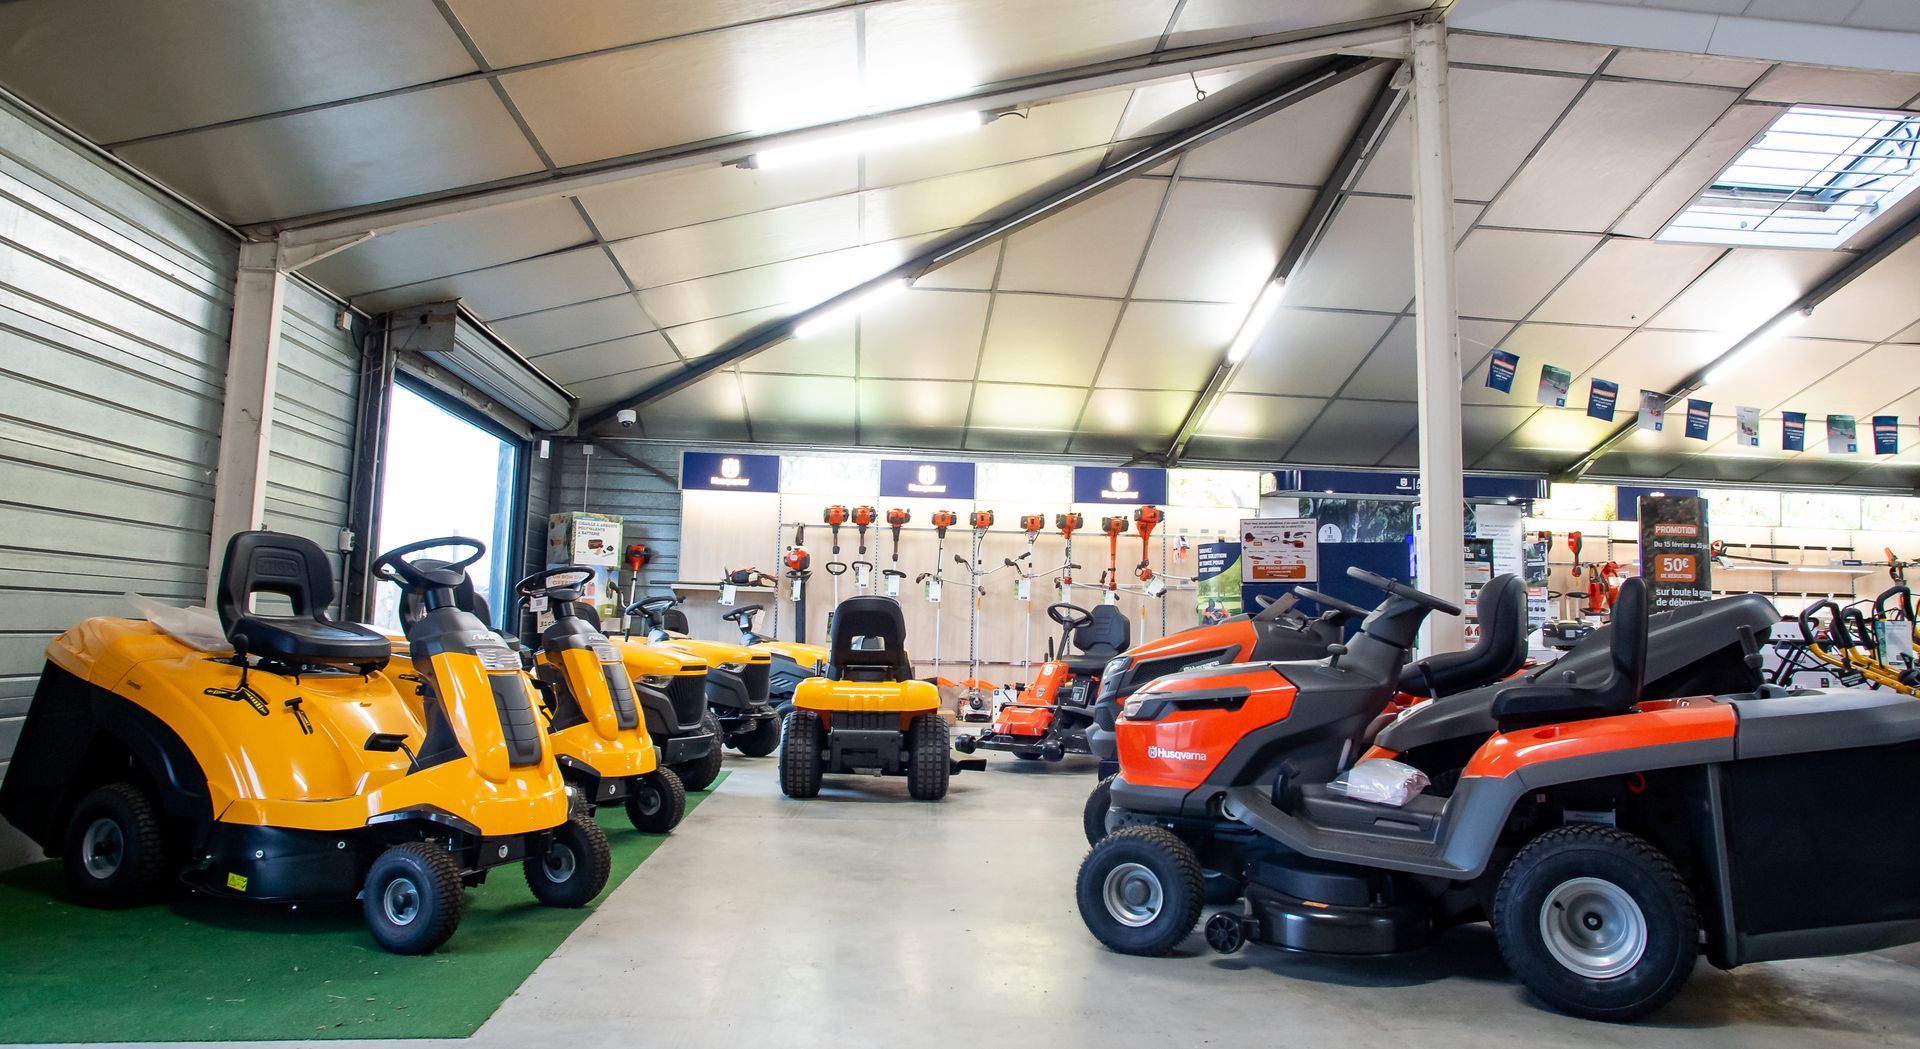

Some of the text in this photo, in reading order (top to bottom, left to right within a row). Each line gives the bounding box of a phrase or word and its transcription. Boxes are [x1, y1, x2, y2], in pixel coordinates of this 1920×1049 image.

[1655, 526, 1696, 534] PROMOTION
[1663, 557, 1689, 572] 50€
[1655, 588, 1670, 596] sur
[1671, 588, 1692, 597] toute
[1692, 588, 1698, 597] la
[1656, 598, 1667, 606] de
[1157, 748, 1206, 761] Husqvarna
